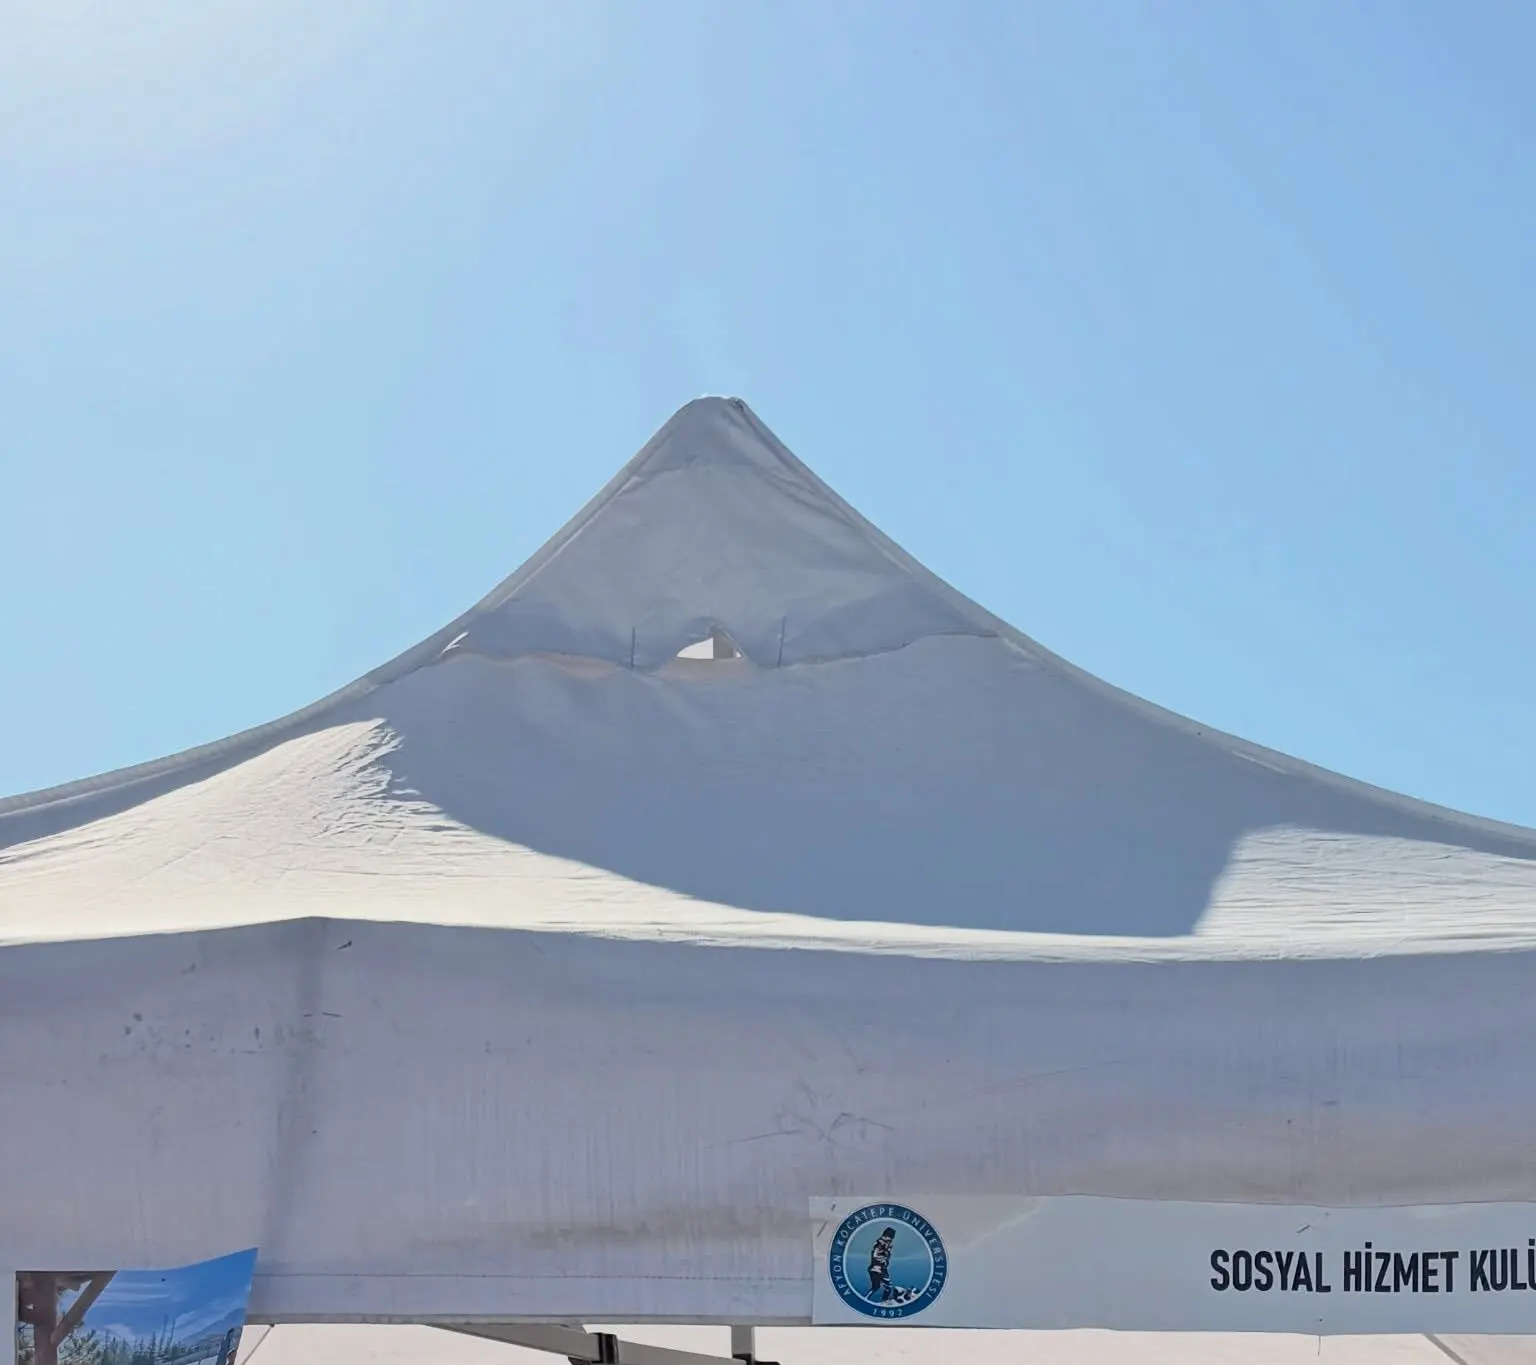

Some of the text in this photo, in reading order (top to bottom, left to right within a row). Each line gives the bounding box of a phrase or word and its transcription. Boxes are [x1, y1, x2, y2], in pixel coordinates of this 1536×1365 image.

[836, 1207, 894, 1247] KOCATEPE
[1210, 1249, 1332, 1292] SOSYAL
[1343, 1241, 1459, 1293] HİZMET
